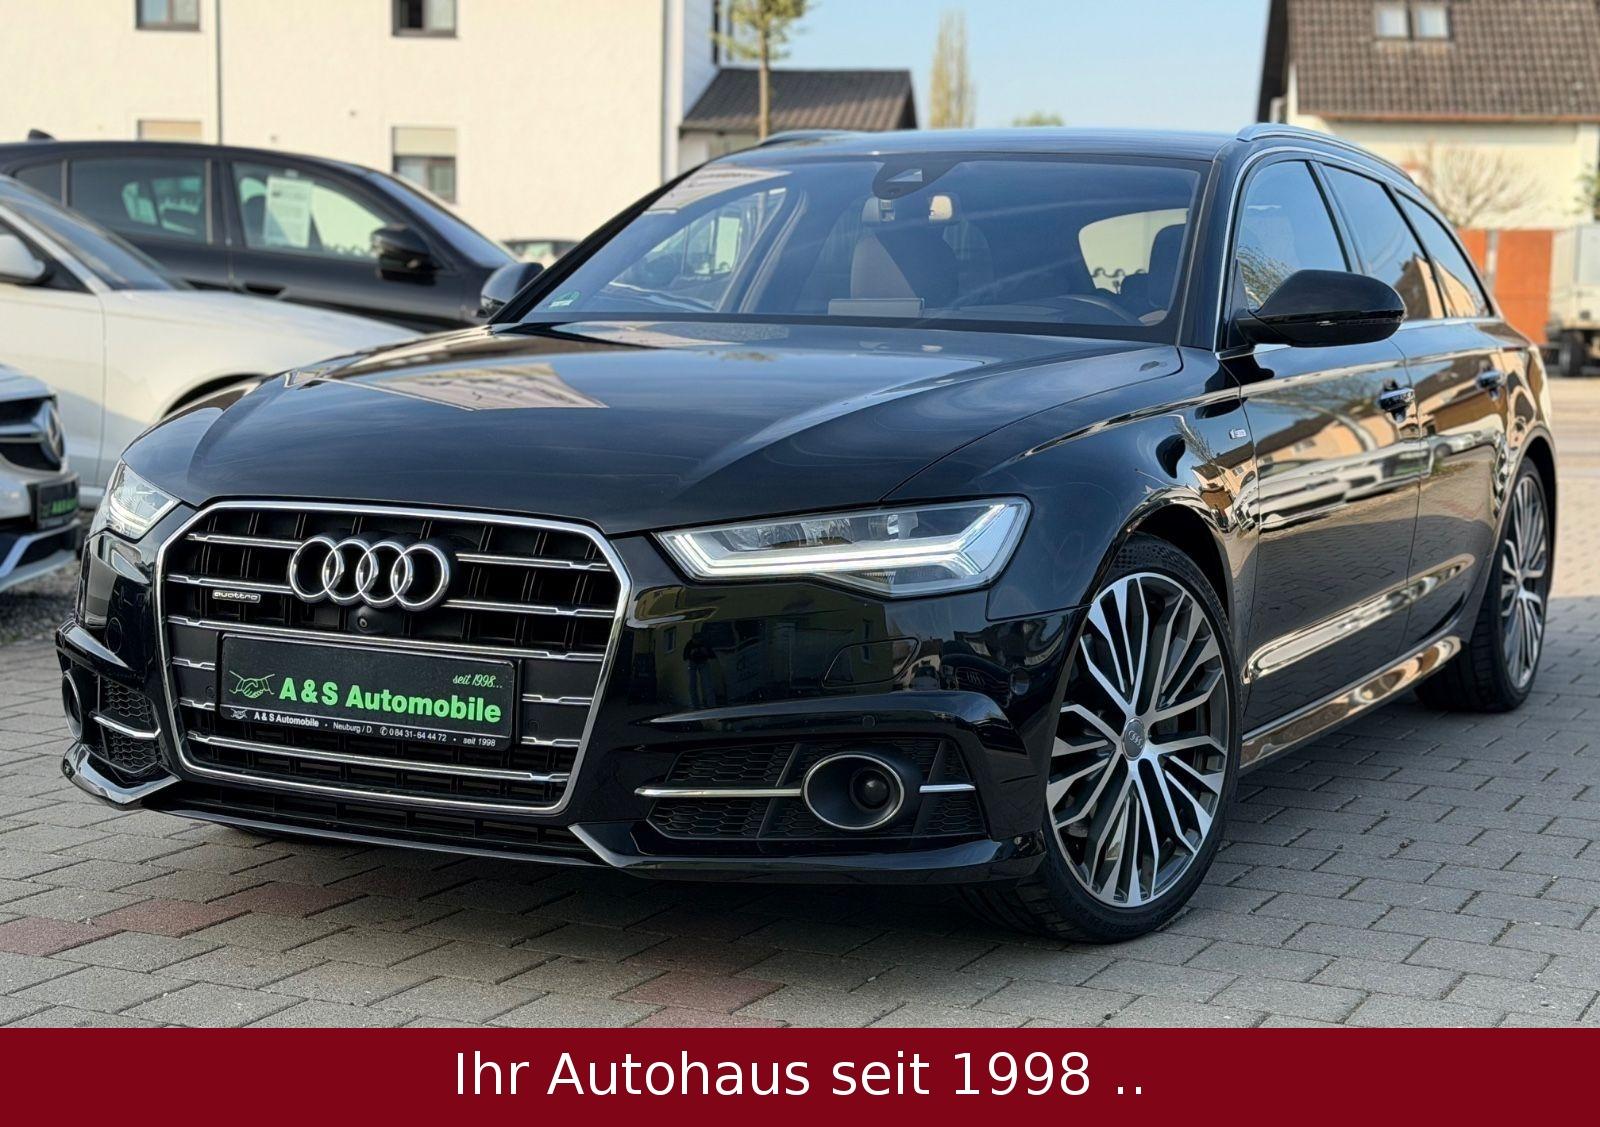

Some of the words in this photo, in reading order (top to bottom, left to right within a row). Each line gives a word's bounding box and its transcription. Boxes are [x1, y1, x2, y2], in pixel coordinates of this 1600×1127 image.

[214, 591, 258, 600] quattro
[452, 674, 471, 685] seit
[279, 677, 297, 701] A
[300, 679, 318, 703] &
[321, 681, 338, 706] S
[345, 684, 501, 723] Automobile
[254, 711, 260, 720] A
[261, 712, 268, 721] &
[269, 713, 275, 722] S
[275, 714, 320, 728] Automobile
[332, 721, 361, 734] Neuburg
[462, 737, 476, 745] seit
[478, 738, 496, 747] 1998
